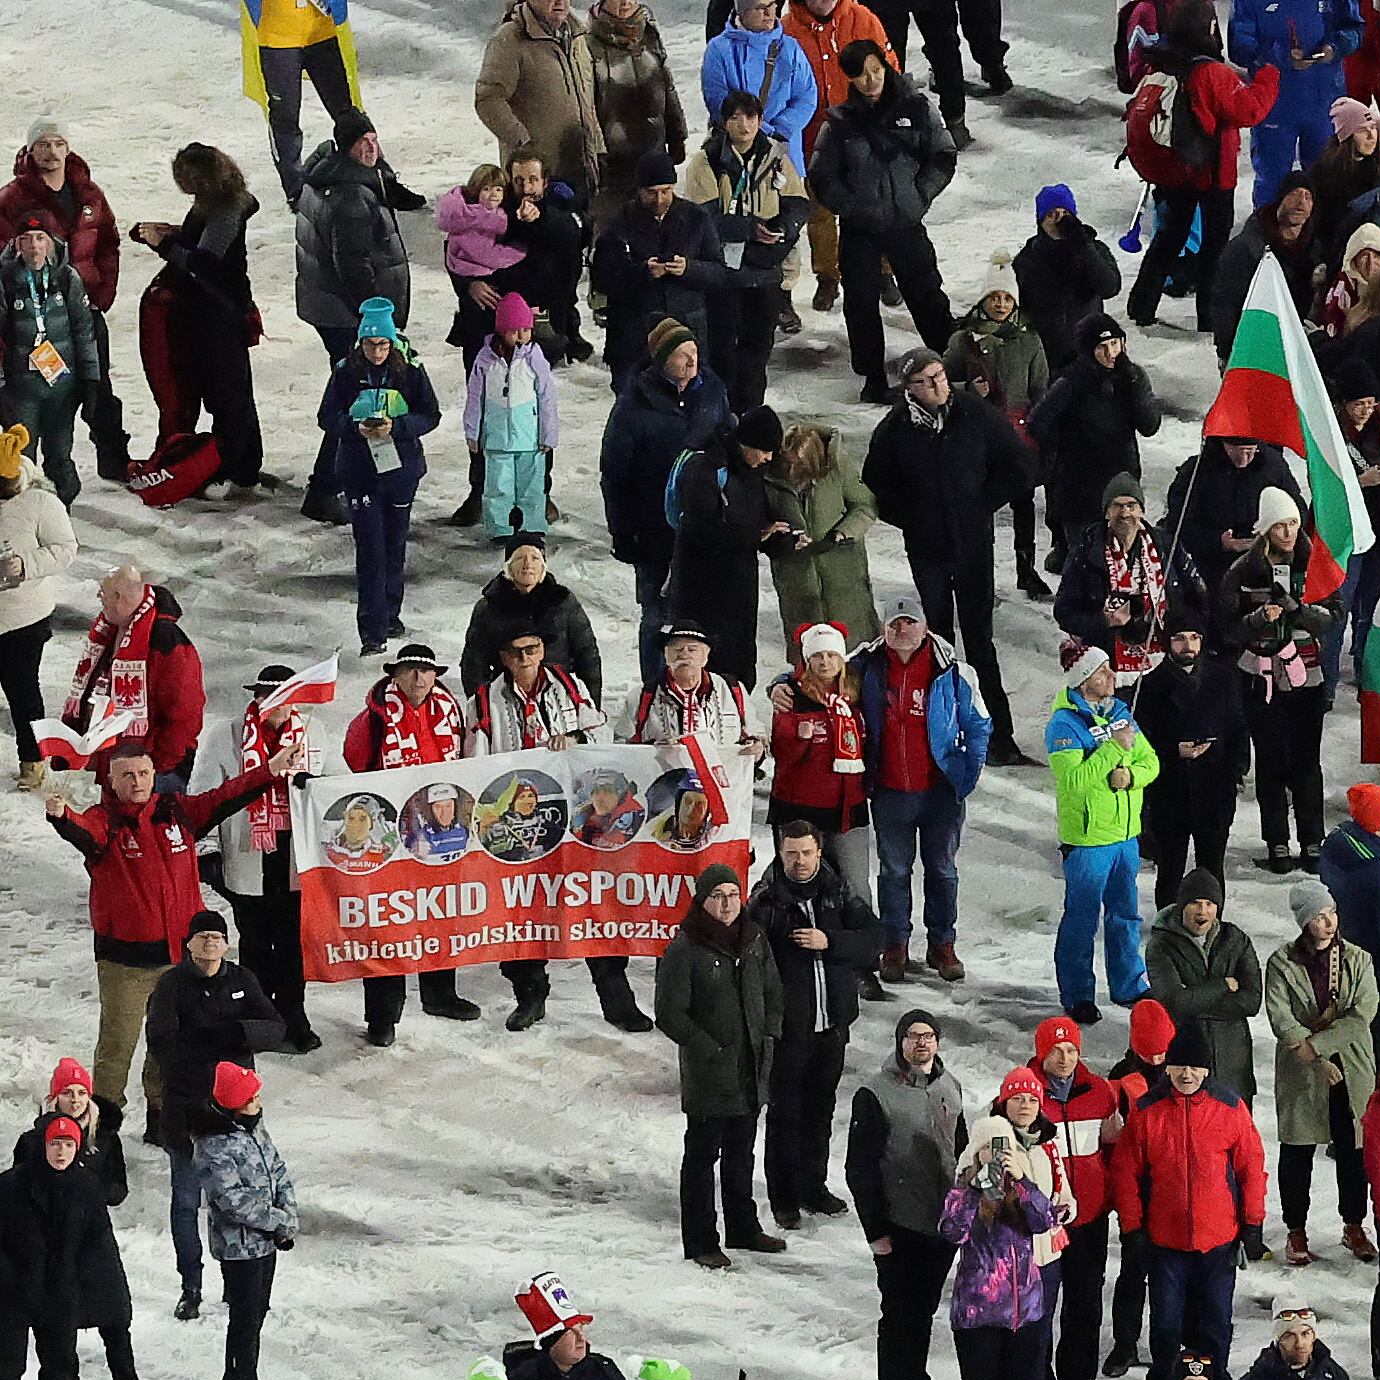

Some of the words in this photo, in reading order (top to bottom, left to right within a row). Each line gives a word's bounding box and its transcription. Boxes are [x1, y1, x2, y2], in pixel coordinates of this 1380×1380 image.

[338, 881, 487, 928] BESKID
[326, 934, 440, 964] kibicuje
[449, 919, 561, 957] polskim
